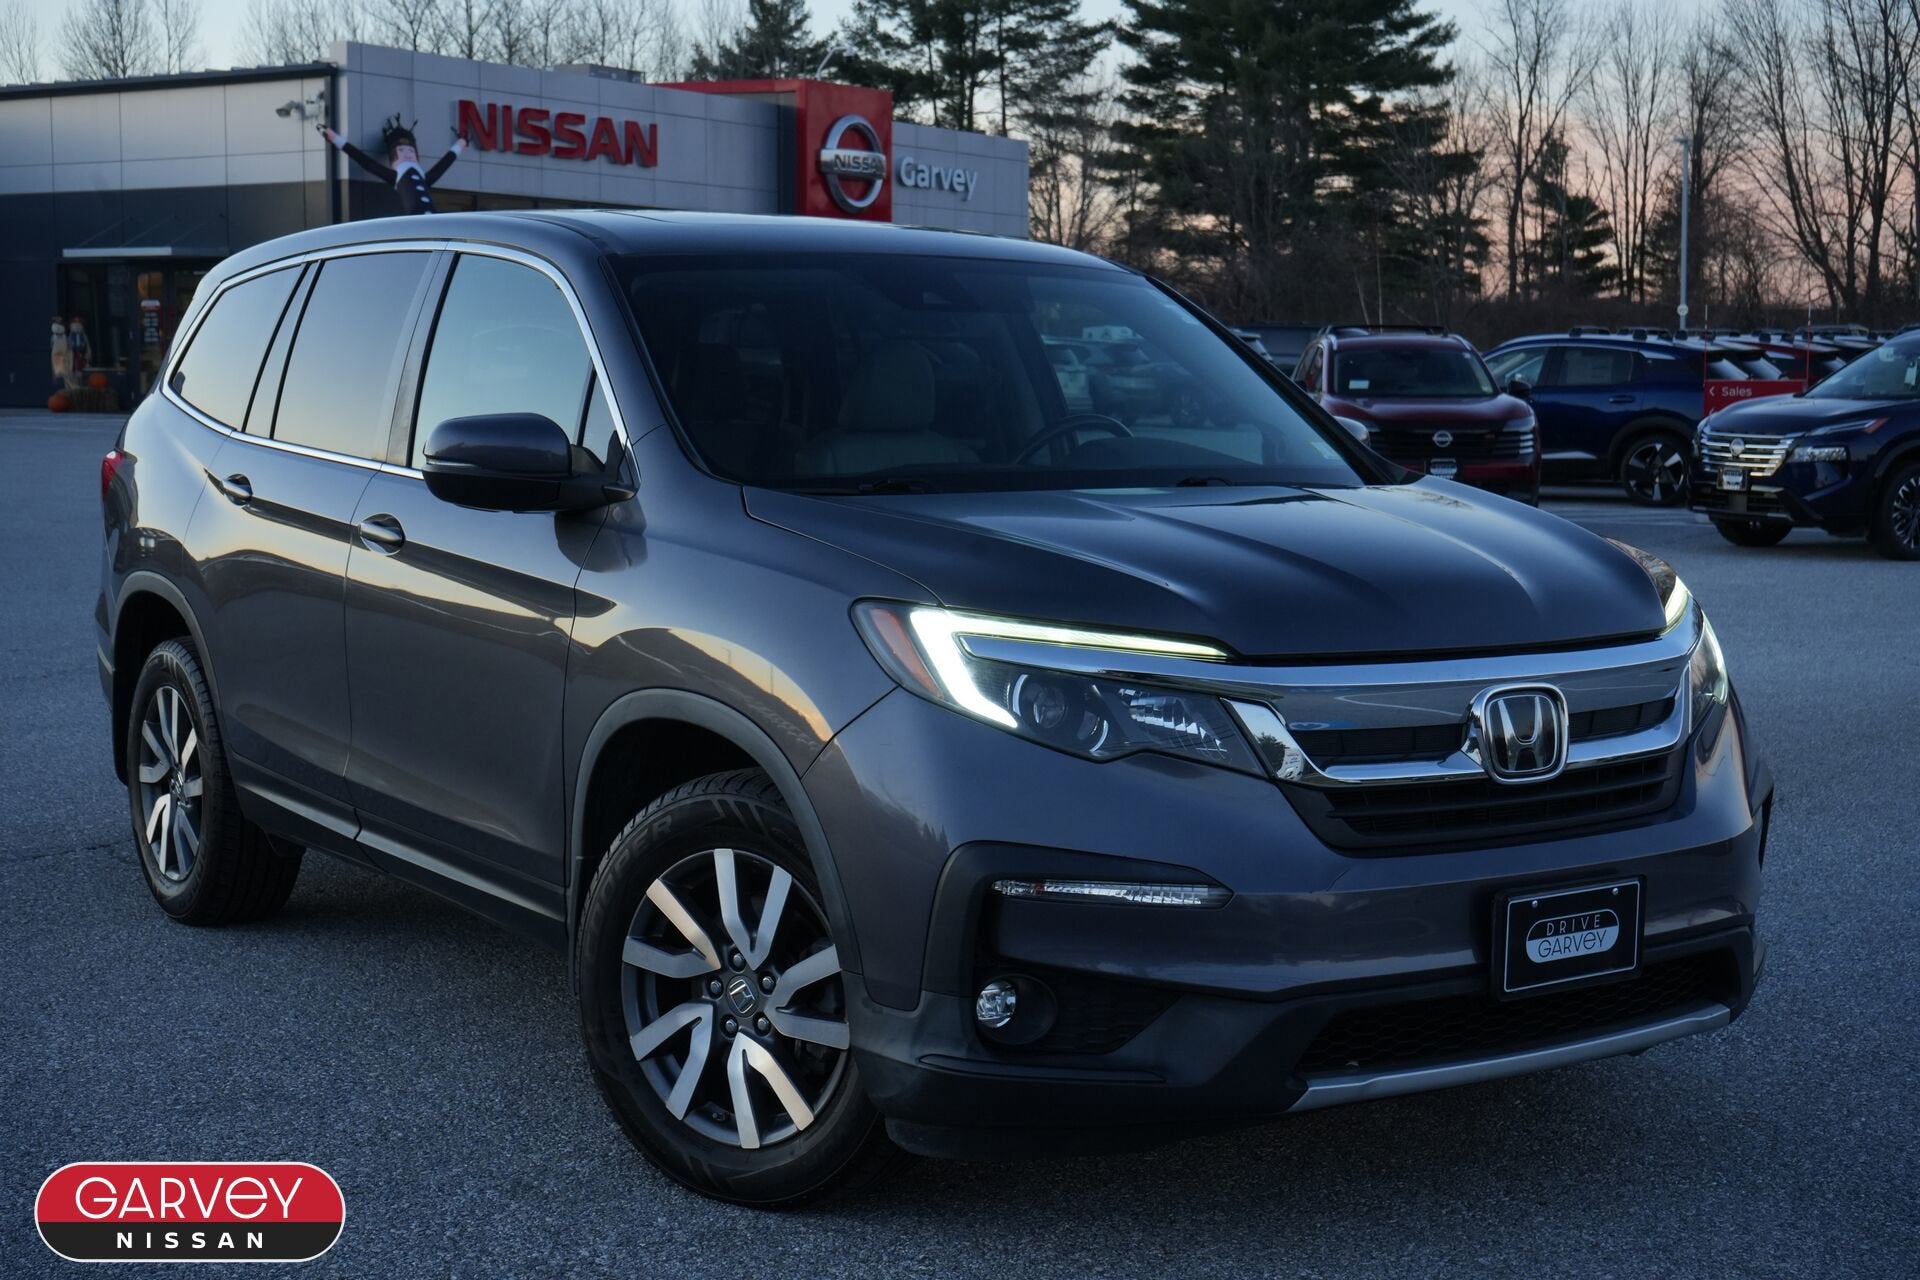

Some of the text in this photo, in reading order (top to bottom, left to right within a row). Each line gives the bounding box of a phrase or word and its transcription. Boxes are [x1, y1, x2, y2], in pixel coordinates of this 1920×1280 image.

[458, 99, 658, 168] NISSAN
[900, 156, 978, 201] Garvey
[1721, 385, 1752, 397] Sales
[1546, 914, 1601, 936] DRIVE
